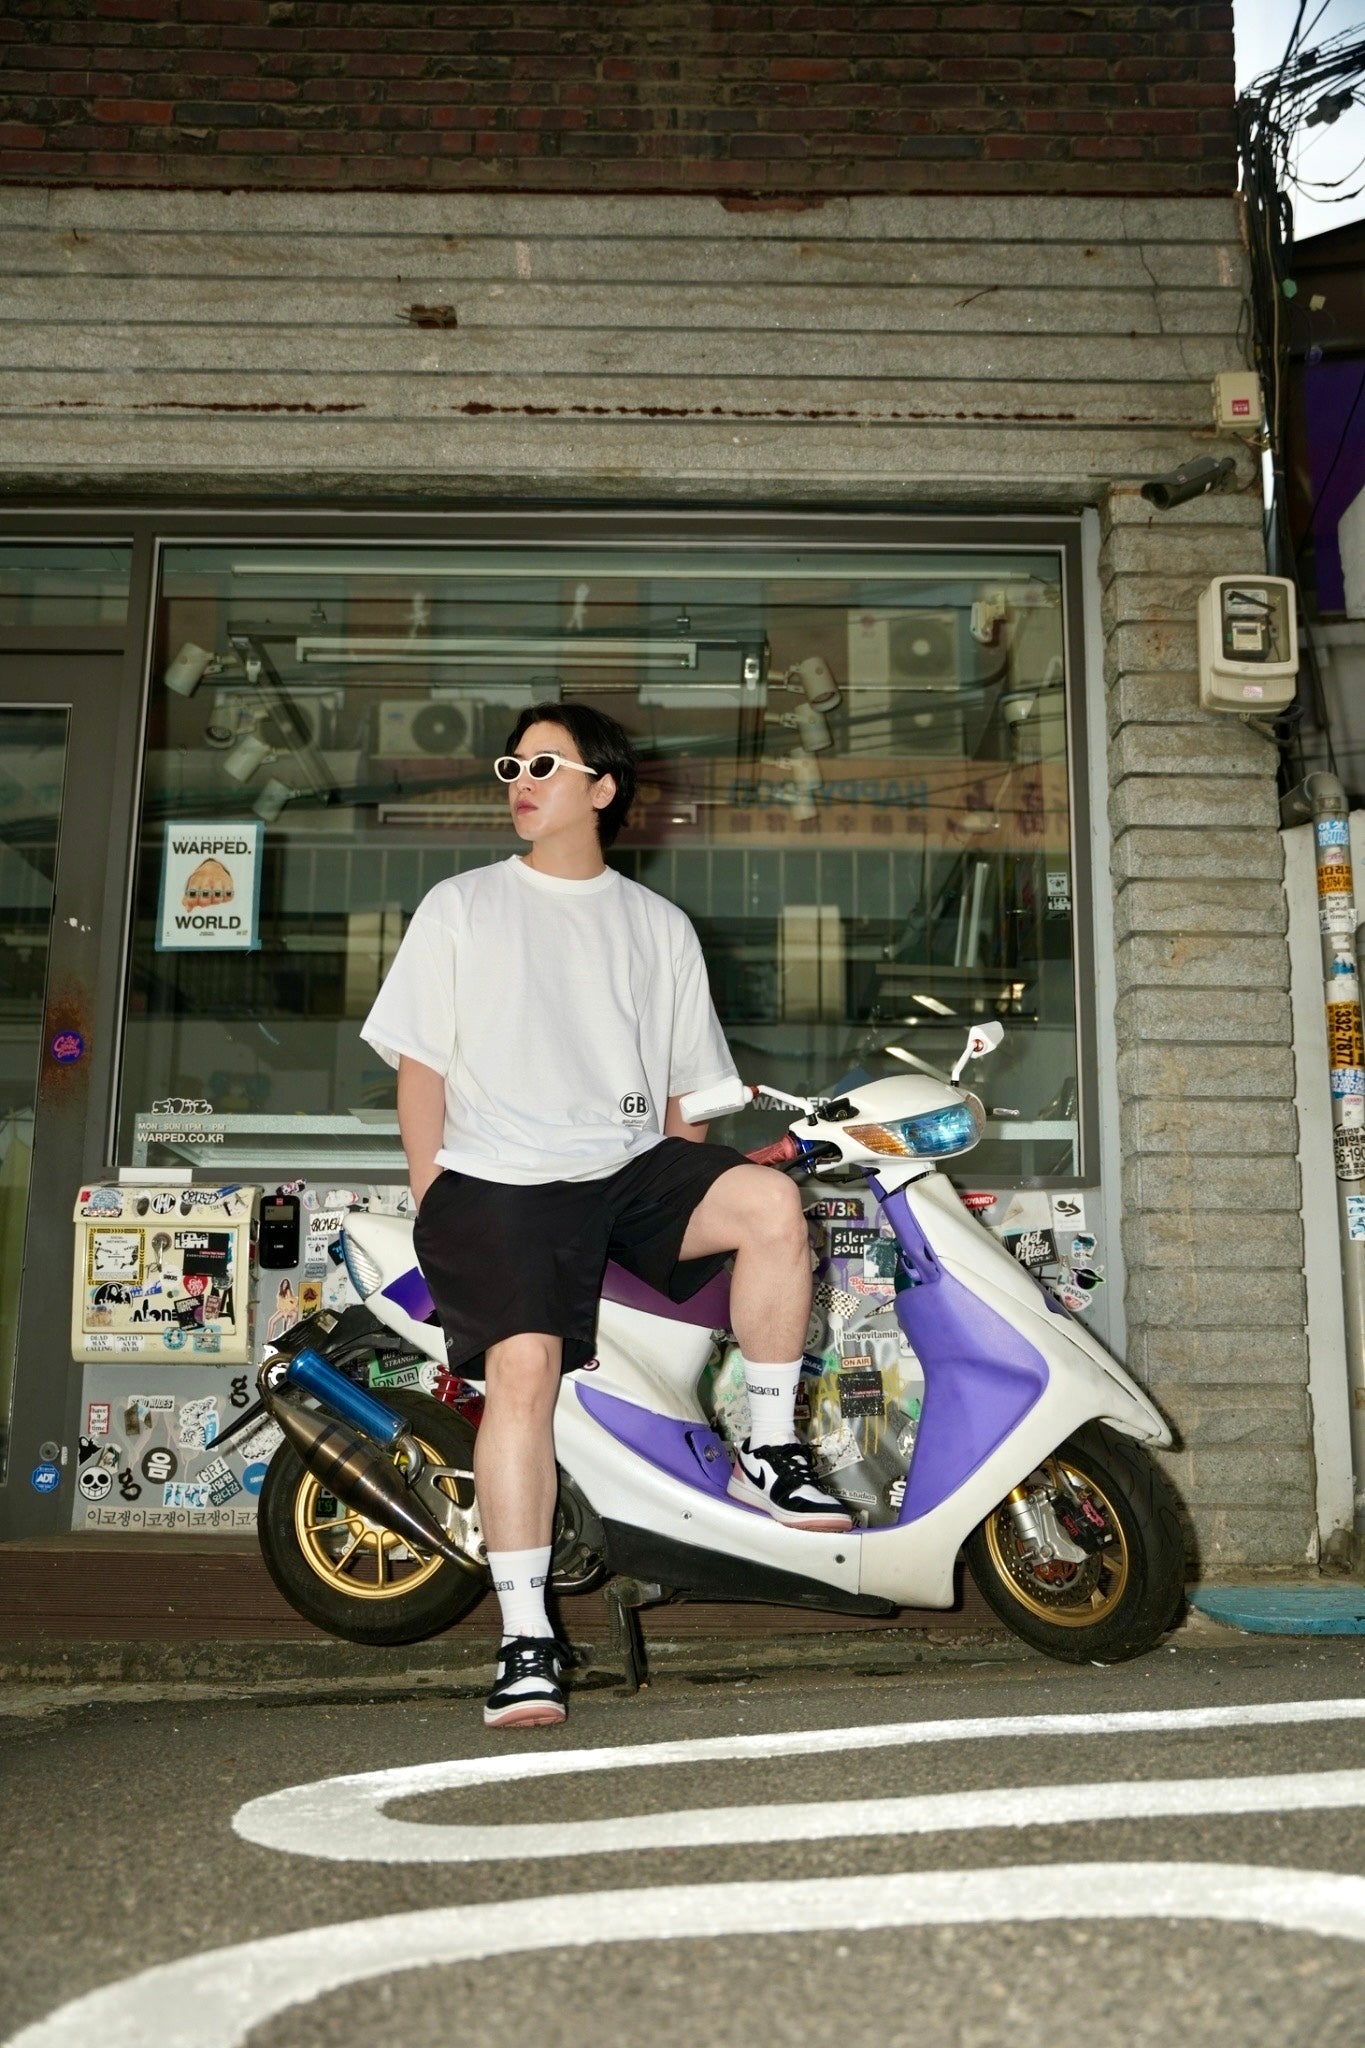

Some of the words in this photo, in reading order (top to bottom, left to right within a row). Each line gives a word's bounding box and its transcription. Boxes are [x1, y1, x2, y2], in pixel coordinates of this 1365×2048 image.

[172, 841, 252, 855] WARPED.
[175, 915, 242, 929] WORLD
[623, 1096, 647, 1113] GB
[138, 1123, 158, 1131] MON
[163, 1123, 181, 1131] SUN
[138, 1133, 224, 1143] WARPED.CO.KR
[1020, 1230, 1043, 1249] get
[1016, 1241, 1051, 1266] lifted
[843, 1331, 898, 1341] tokyovitamin
[857, 1358, 870, 1366] AIR
[396, 1372, 415, 1384] AIR
[36, 1473, 55, 1484] ADT
